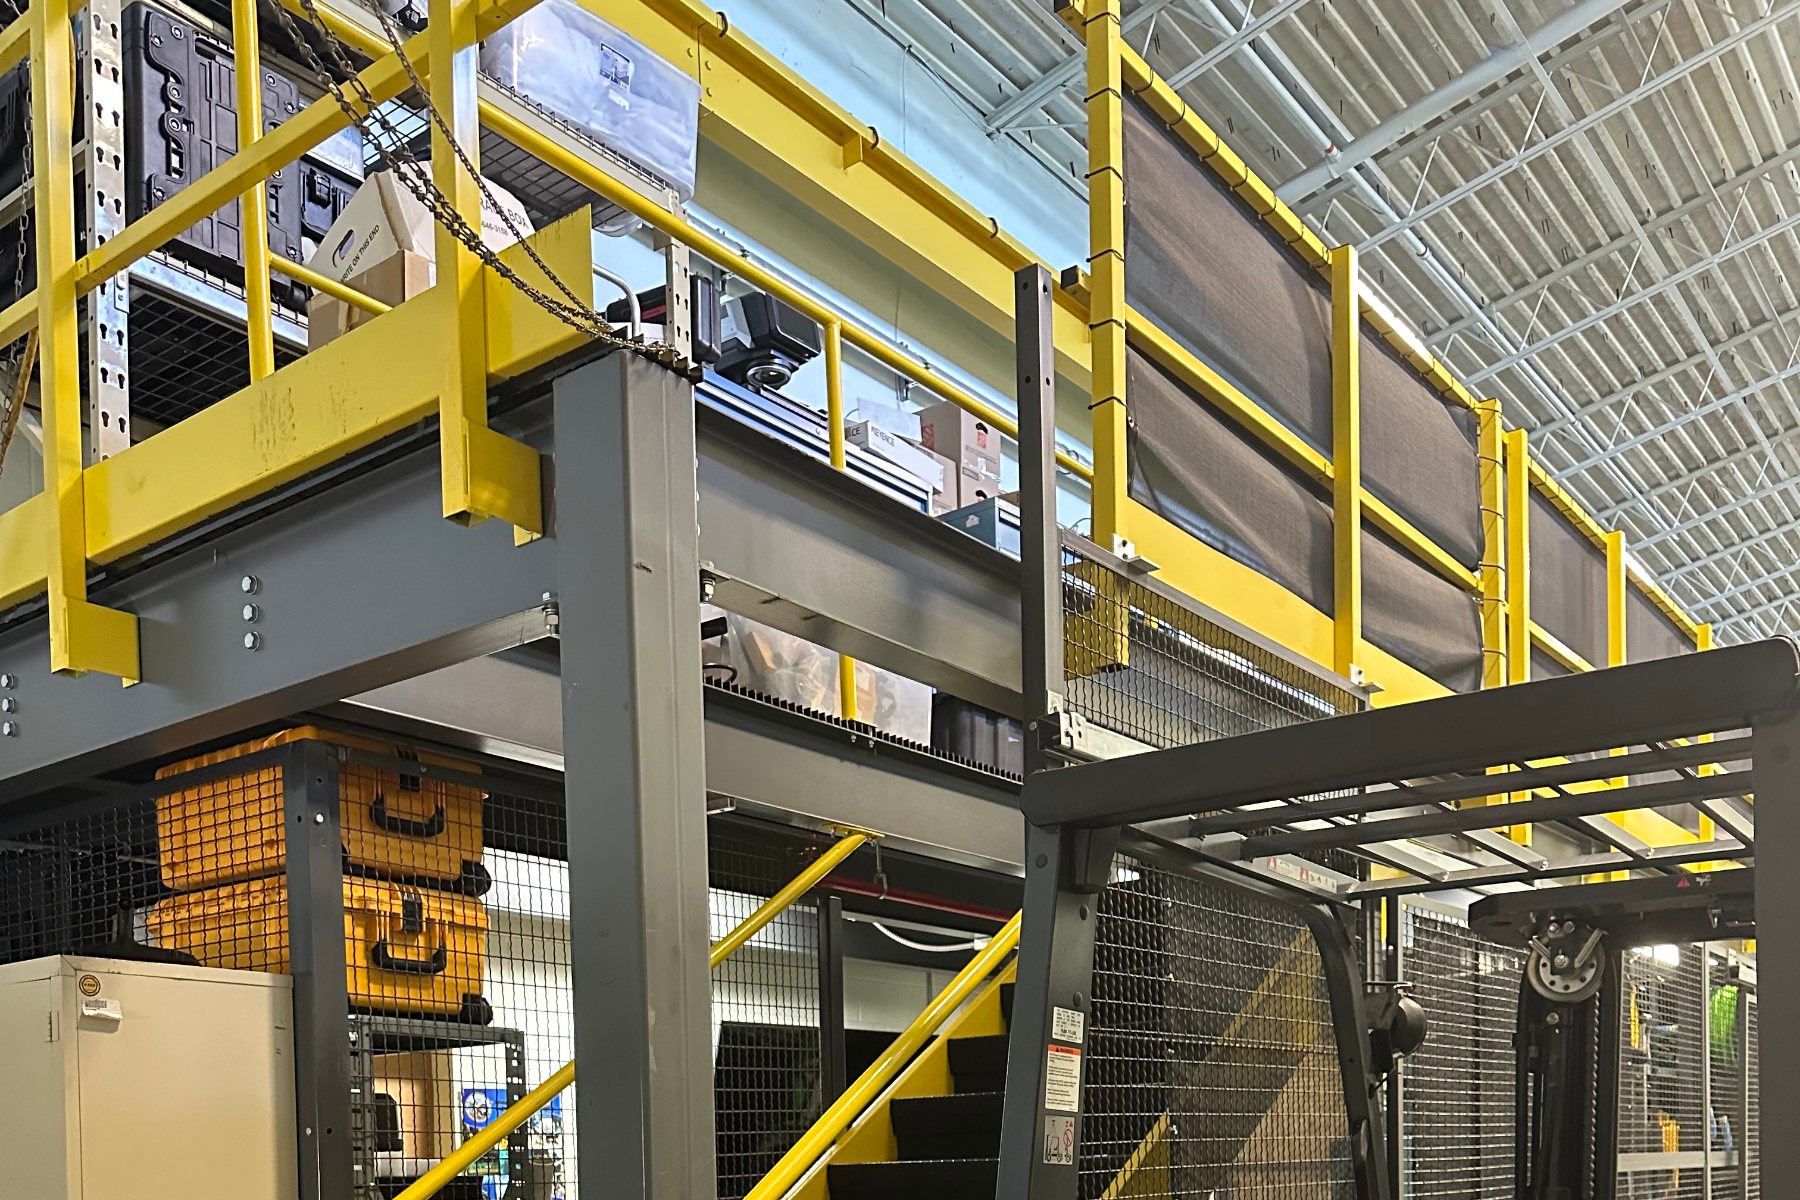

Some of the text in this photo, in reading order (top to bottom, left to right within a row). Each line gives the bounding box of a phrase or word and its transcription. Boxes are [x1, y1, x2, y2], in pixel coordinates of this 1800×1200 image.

[507, 208, 529, 229] BOX
[352, 254, 360, 266] ON
[359, 239, 370, 256] THIS
[369, 224, 380, 241] END
